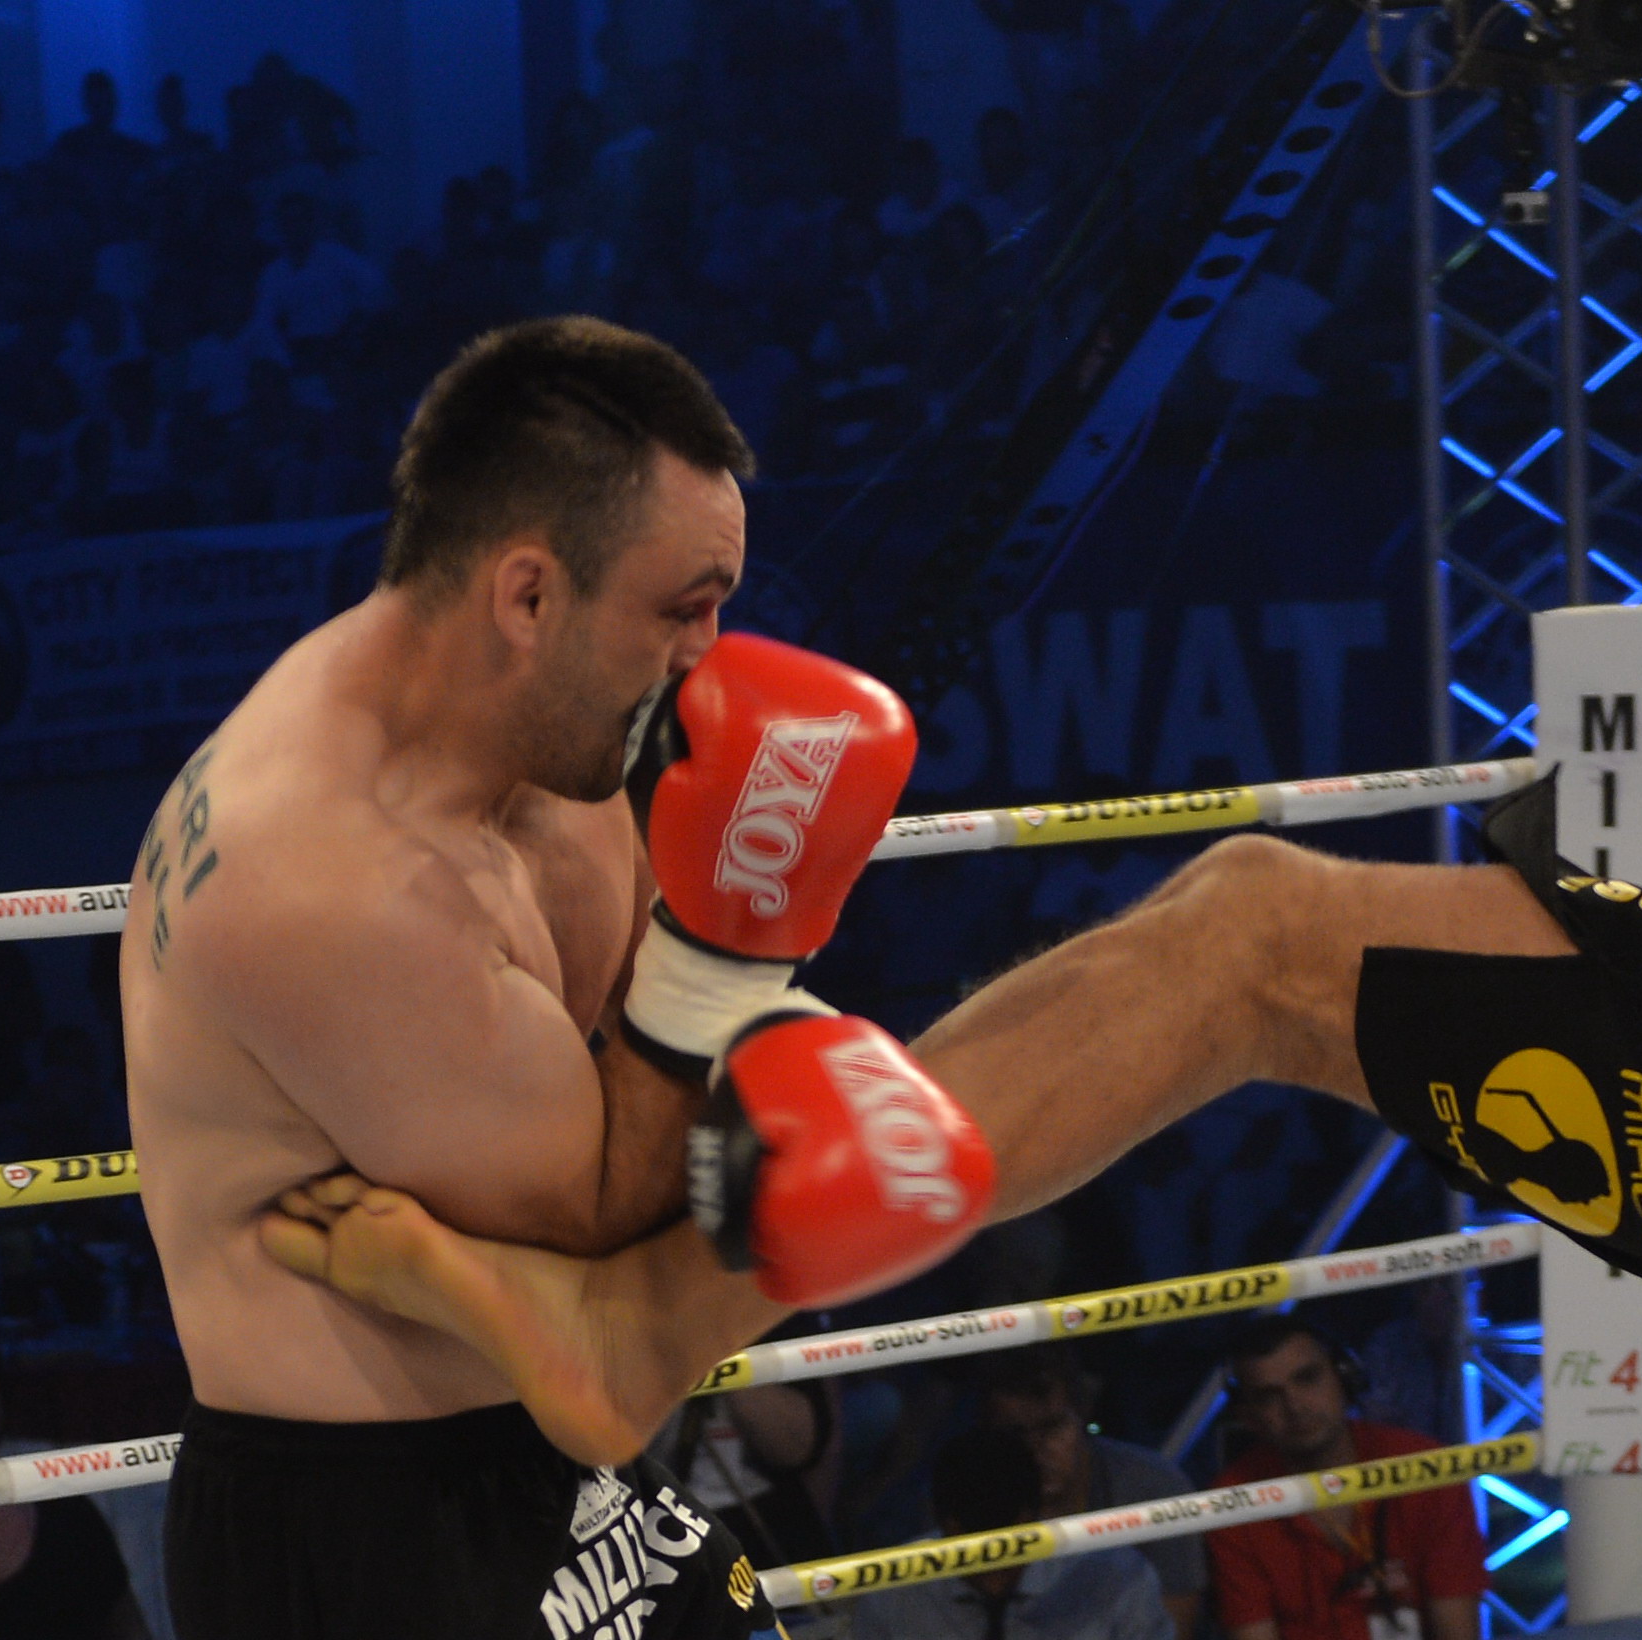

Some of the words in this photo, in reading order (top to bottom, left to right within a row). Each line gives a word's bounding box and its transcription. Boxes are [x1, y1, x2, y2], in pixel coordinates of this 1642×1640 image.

[709, 710, 861, 919] JOYA
[1061, 789, 1244, 824] DUNLOP
[1097, 1274, 1278, 1323] DUNLOP
[800, 1311, 1019, 1365] www.auto-soft.ro
[1608, 1349, 1641, 1395] 4
[1359, 1442, 1524, 1491] DUNLOP
[850, 1532, 1041, 1590] DUNLOP
